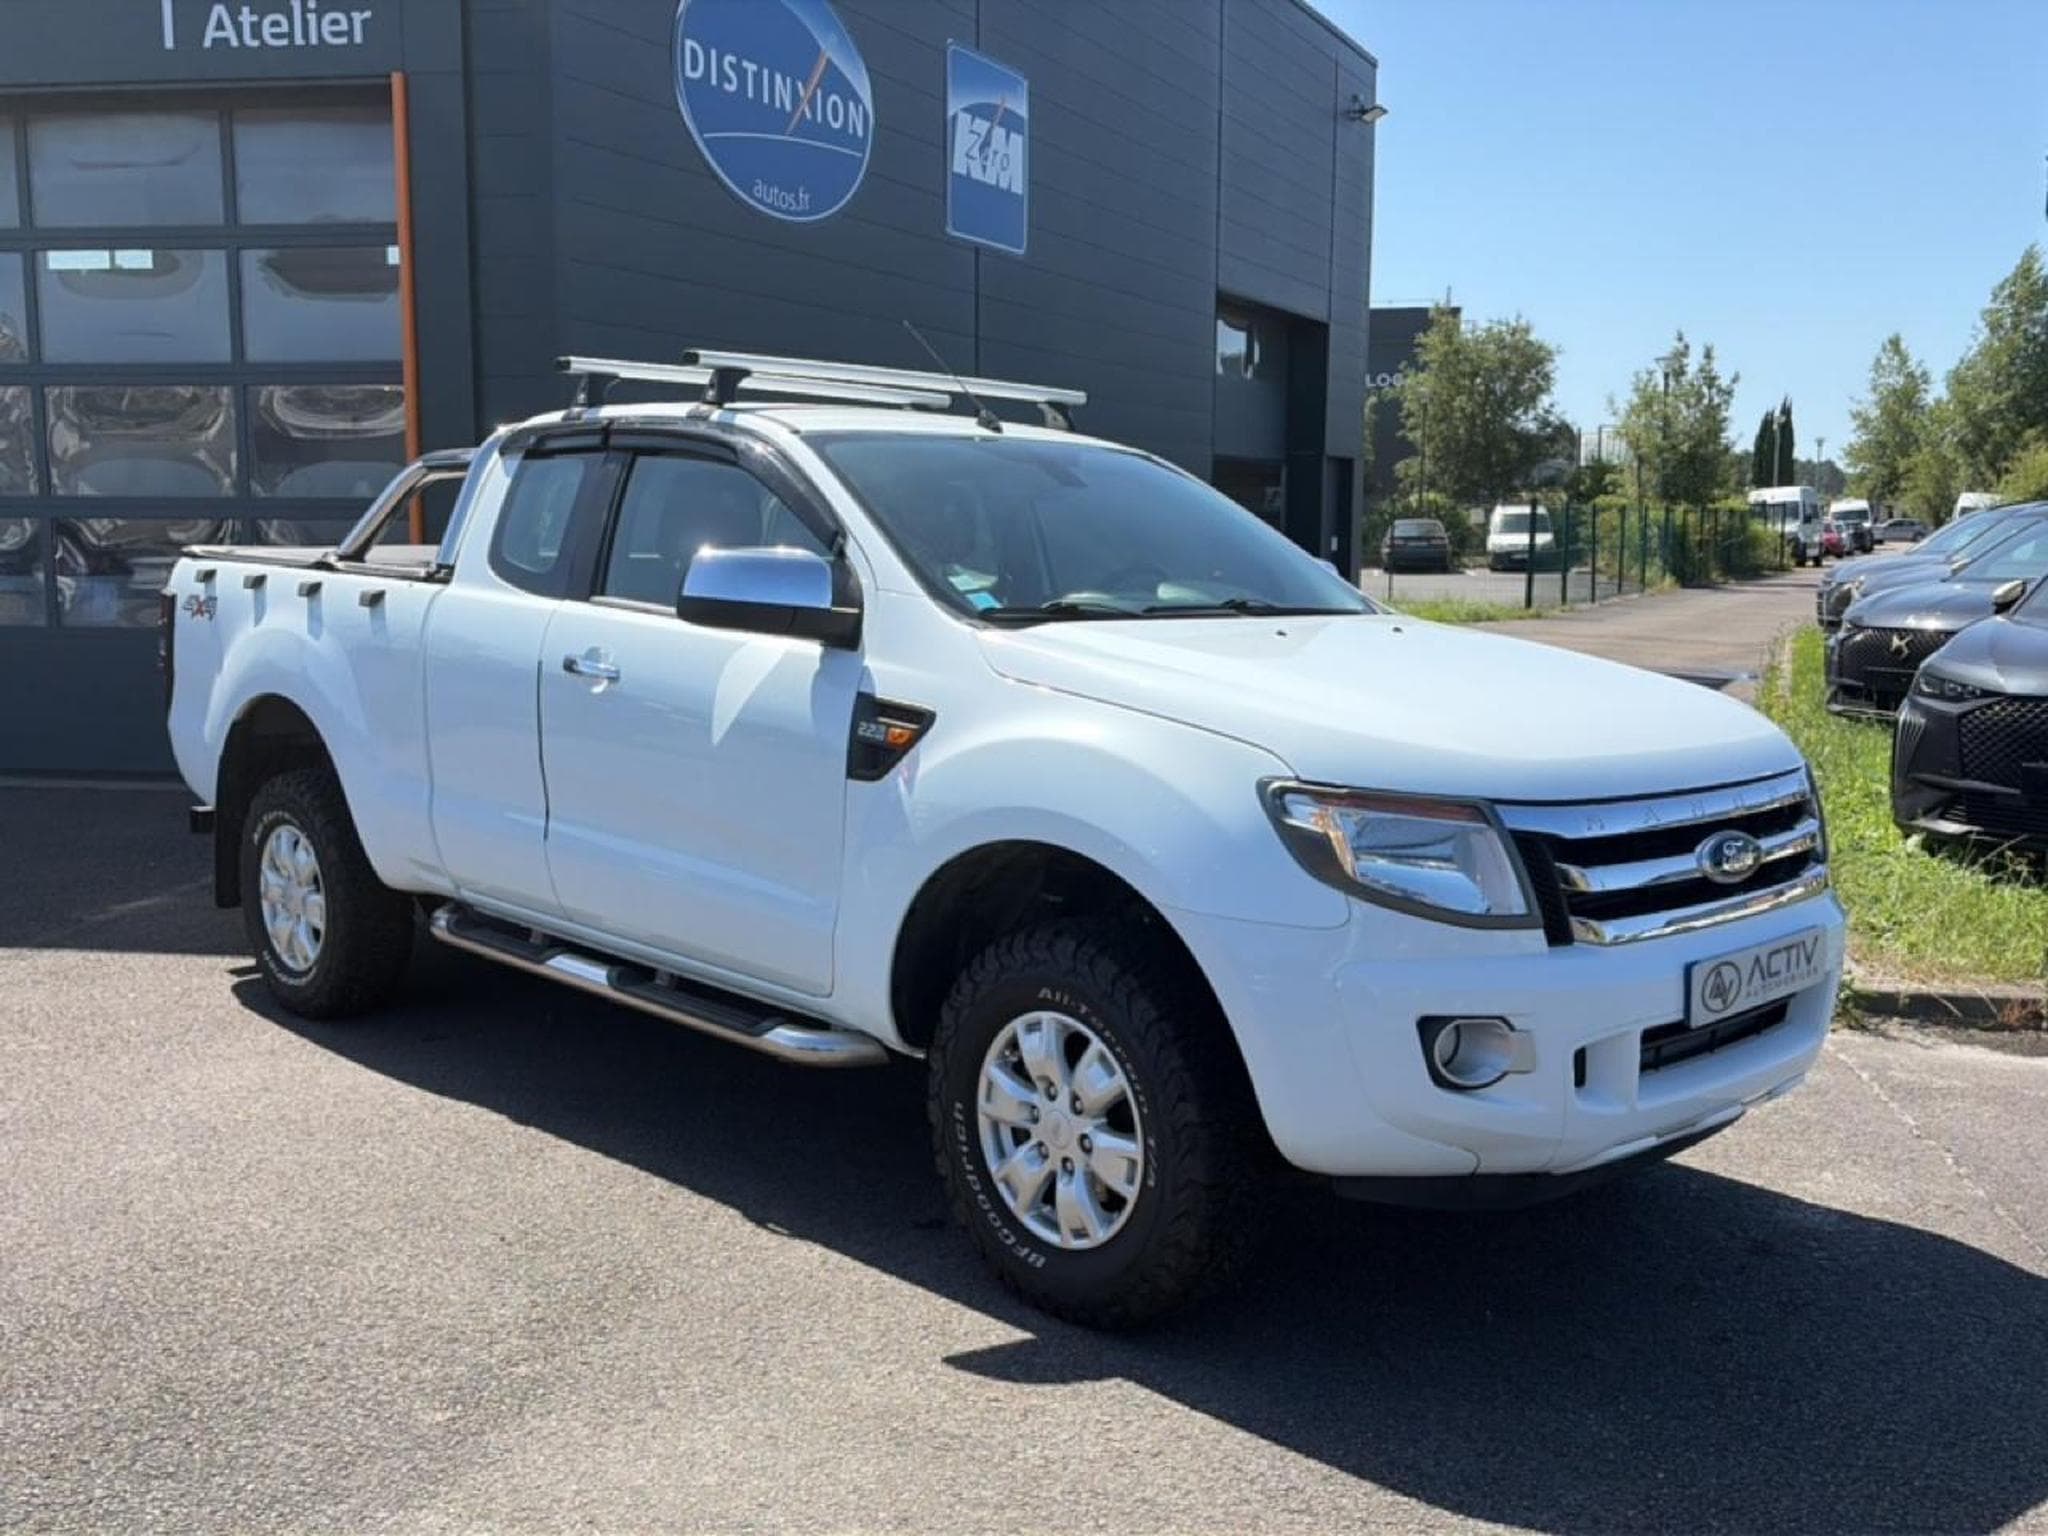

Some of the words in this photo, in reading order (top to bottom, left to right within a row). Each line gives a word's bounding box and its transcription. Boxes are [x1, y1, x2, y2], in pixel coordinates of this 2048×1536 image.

[203, 0, 372, 48] Atelier
[684, 37, 864, 138] DISTINXION
[753, 178, 810, 210] autos.fr
[1747, 934, 1819, 987] ACTIV
